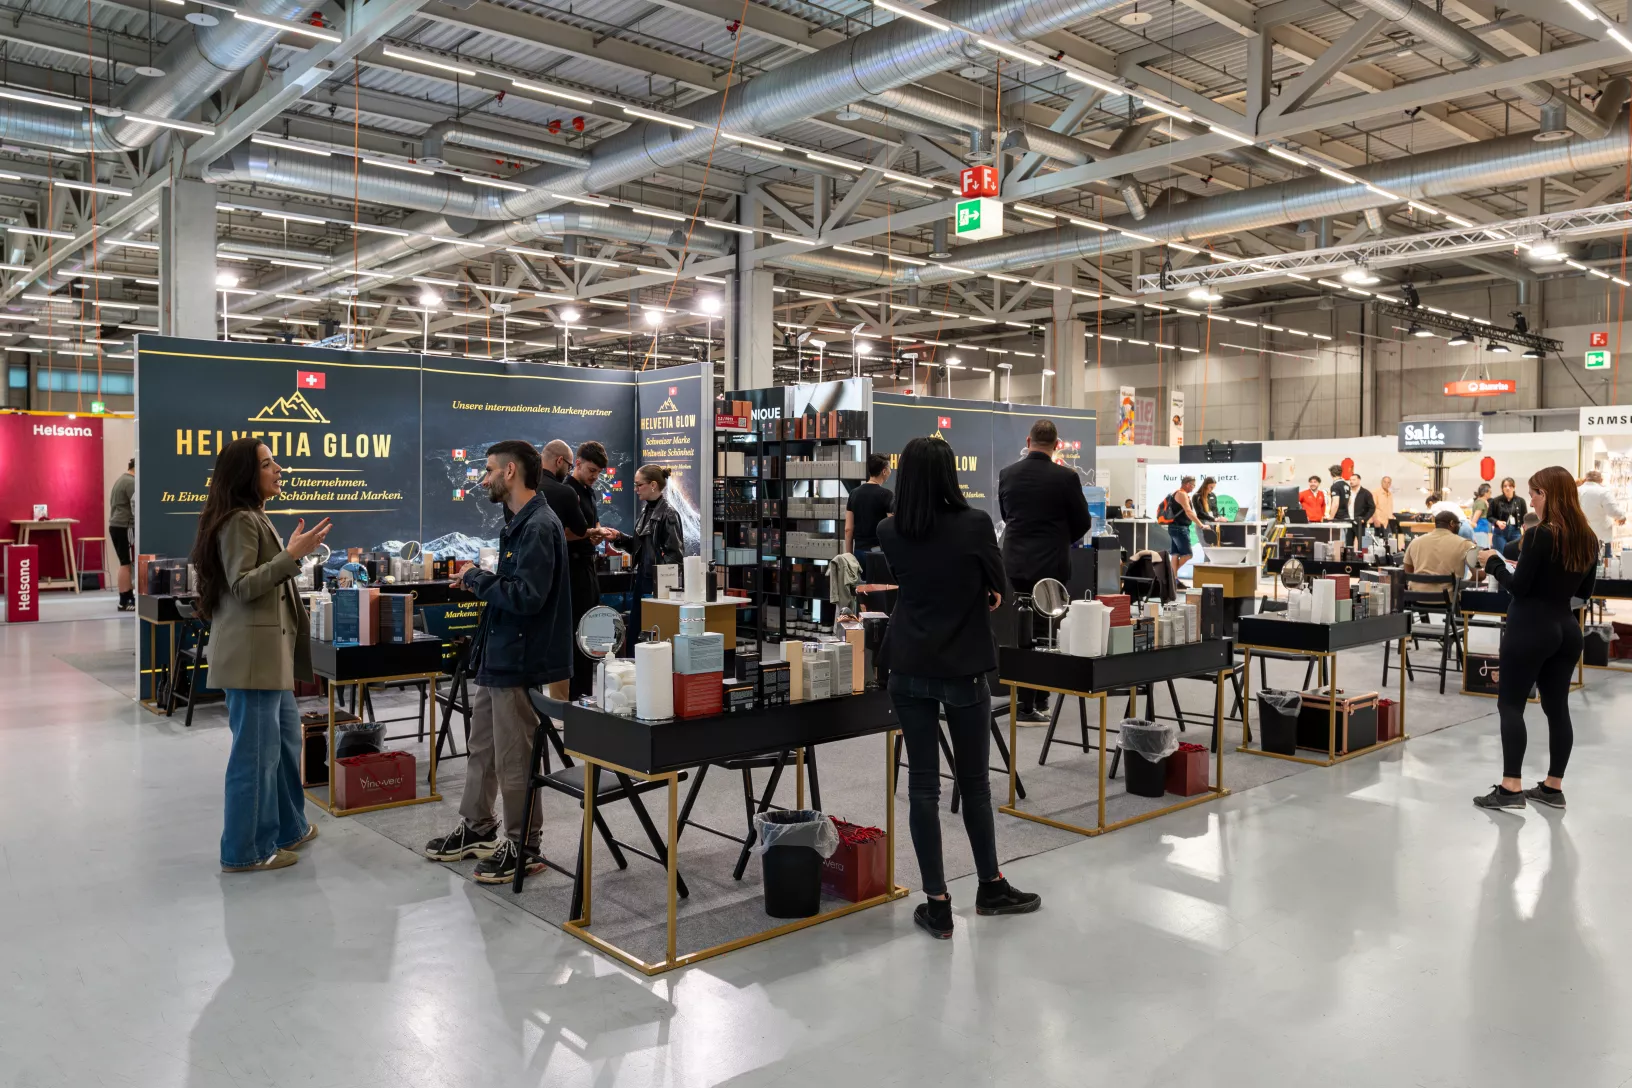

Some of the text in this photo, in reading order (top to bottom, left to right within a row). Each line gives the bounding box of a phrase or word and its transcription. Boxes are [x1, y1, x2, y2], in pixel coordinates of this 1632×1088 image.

[963, 170, 973, 193] F
[983, 168, 992, 190] F
[1592, 333, 1601, 345] F
[452, 400, 613, 418] Unsere internationalen Markenpartner
[751, 407, 781, 420] NIQUE
[640, 414, 696, 430] HELVETIA GLOW
[1587, 415, 1632, 426] SAMS
[33, 424, 93, 437] Helsana
[1404, 423, 1445, 441] Salt.
[176, 429, 392, 458] HELTIA GLOW
[645, 435, 691, 446] Schweizer Marke
[642, 447, 695, 457] Weltweite Schönheit
[955, 456, 977, 472] LOW
[290, 477, 368, 488] Unternehmen.
[1217, 474, 1239, 482] jetzt.
[161, 491, 175, 502] In
[278, 491, 335, 501] Schönheit
[336, 490, 358, 501] und
[359, 490, 404, 501] Marken.
[18, 558, 30, 611] Helsana
[444, 610, 479, 619] Markena
